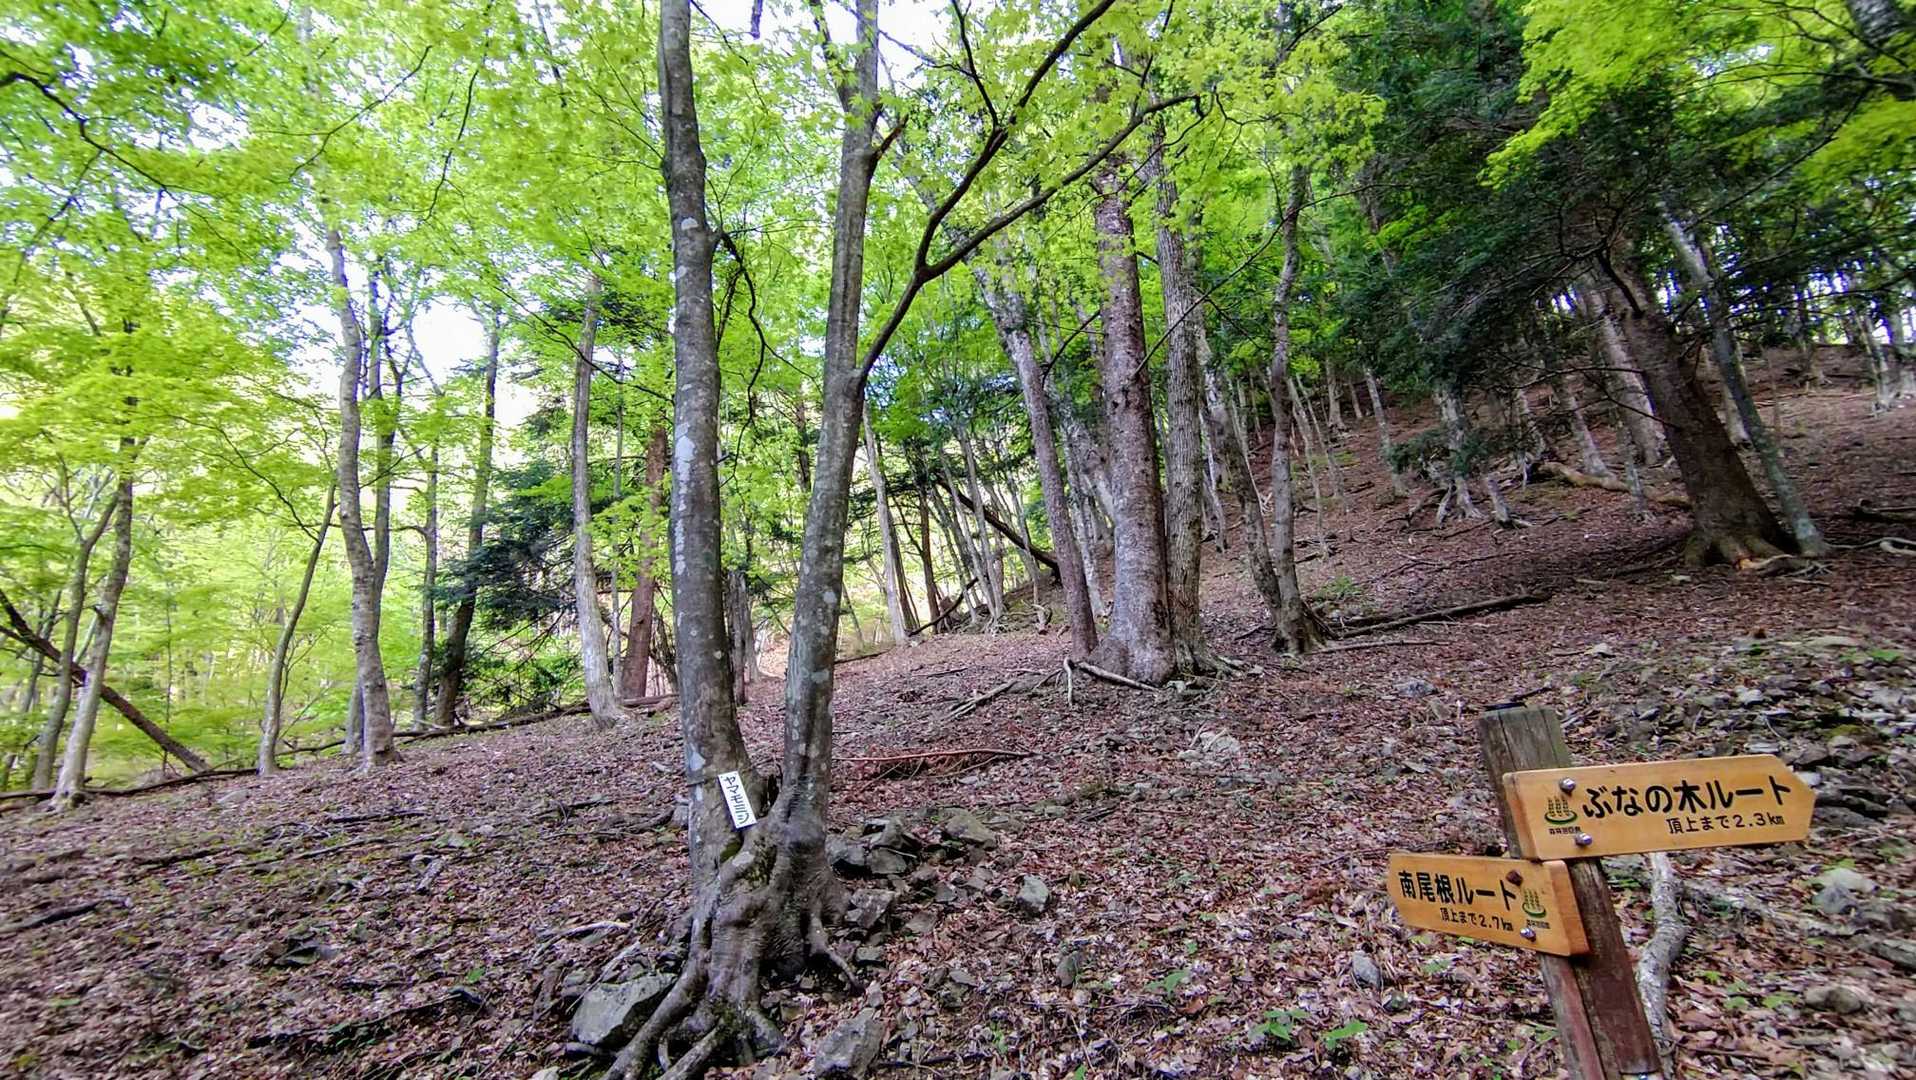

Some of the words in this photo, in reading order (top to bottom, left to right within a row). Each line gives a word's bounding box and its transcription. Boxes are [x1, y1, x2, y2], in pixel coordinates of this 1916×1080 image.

[1582, 775, 1791, 819] ぶなの木ルート
[1398, 870, 1516, 911] 南尾根ルート
